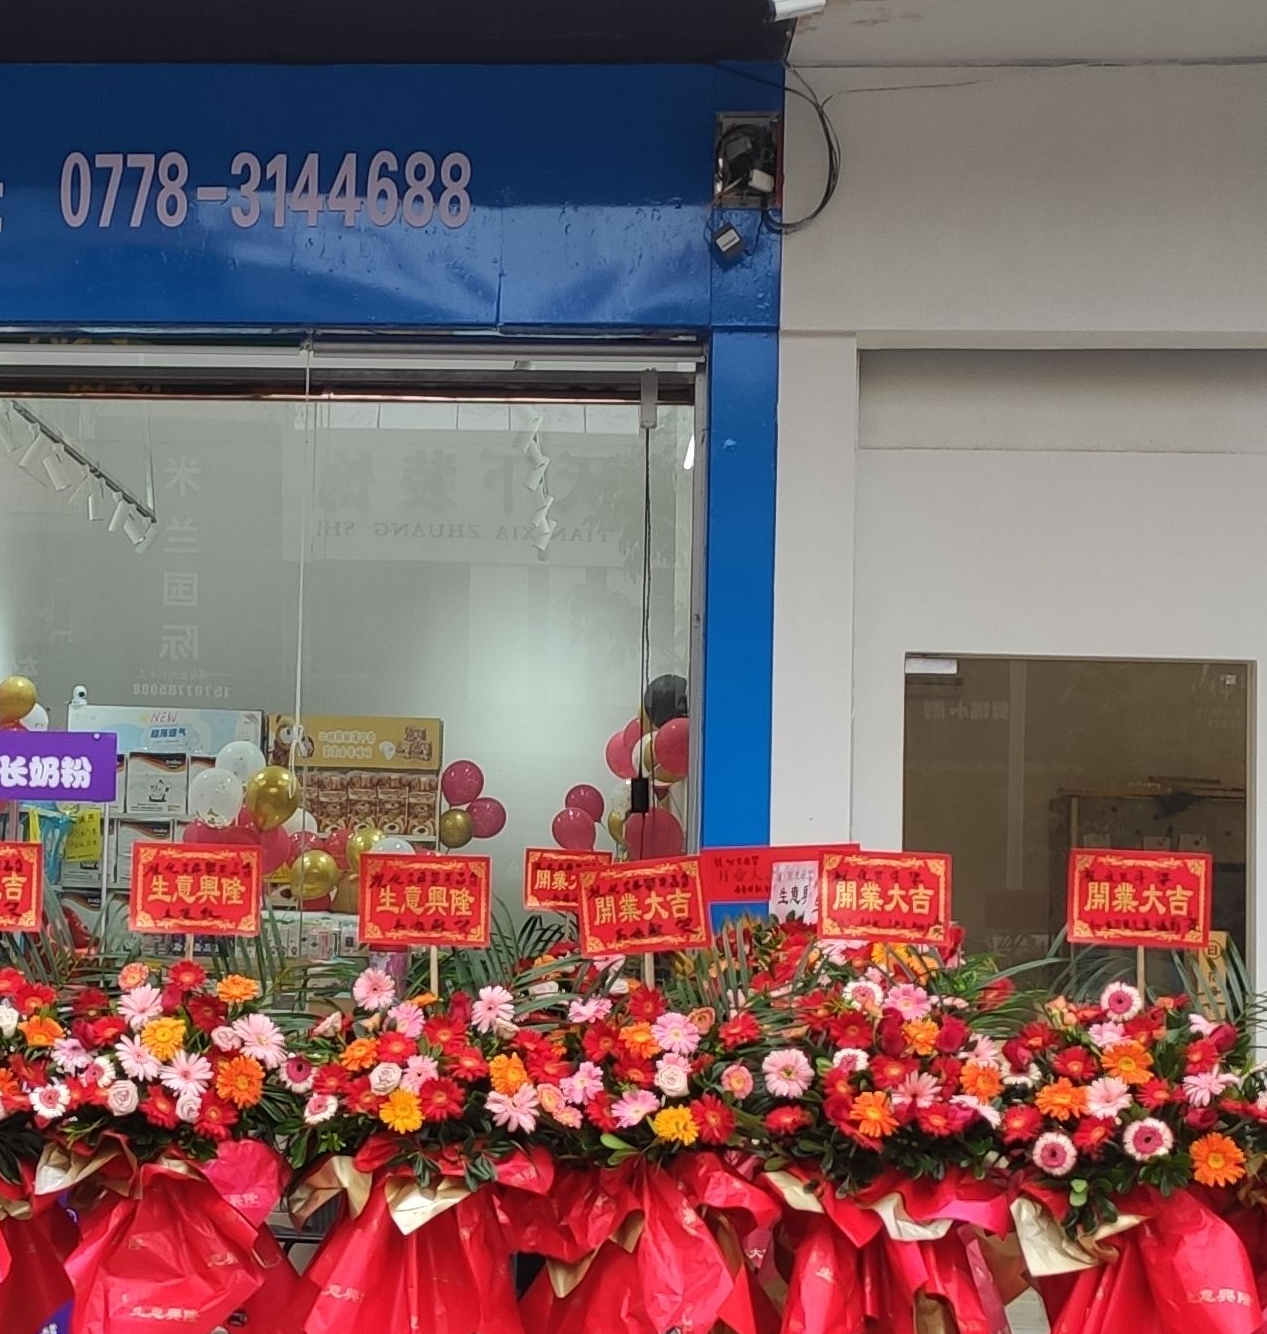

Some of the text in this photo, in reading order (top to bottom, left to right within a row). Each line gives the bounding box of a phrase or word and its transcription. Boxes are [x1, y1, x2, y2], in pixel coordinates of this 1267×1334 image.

[59, 151, 472, 230] 0778-3144688
[594, 887, 692, 926] 開業大吉
[833, 881, 935, 916] 開業大吉
[1084, 881, 1194, 917] 開業大吉
